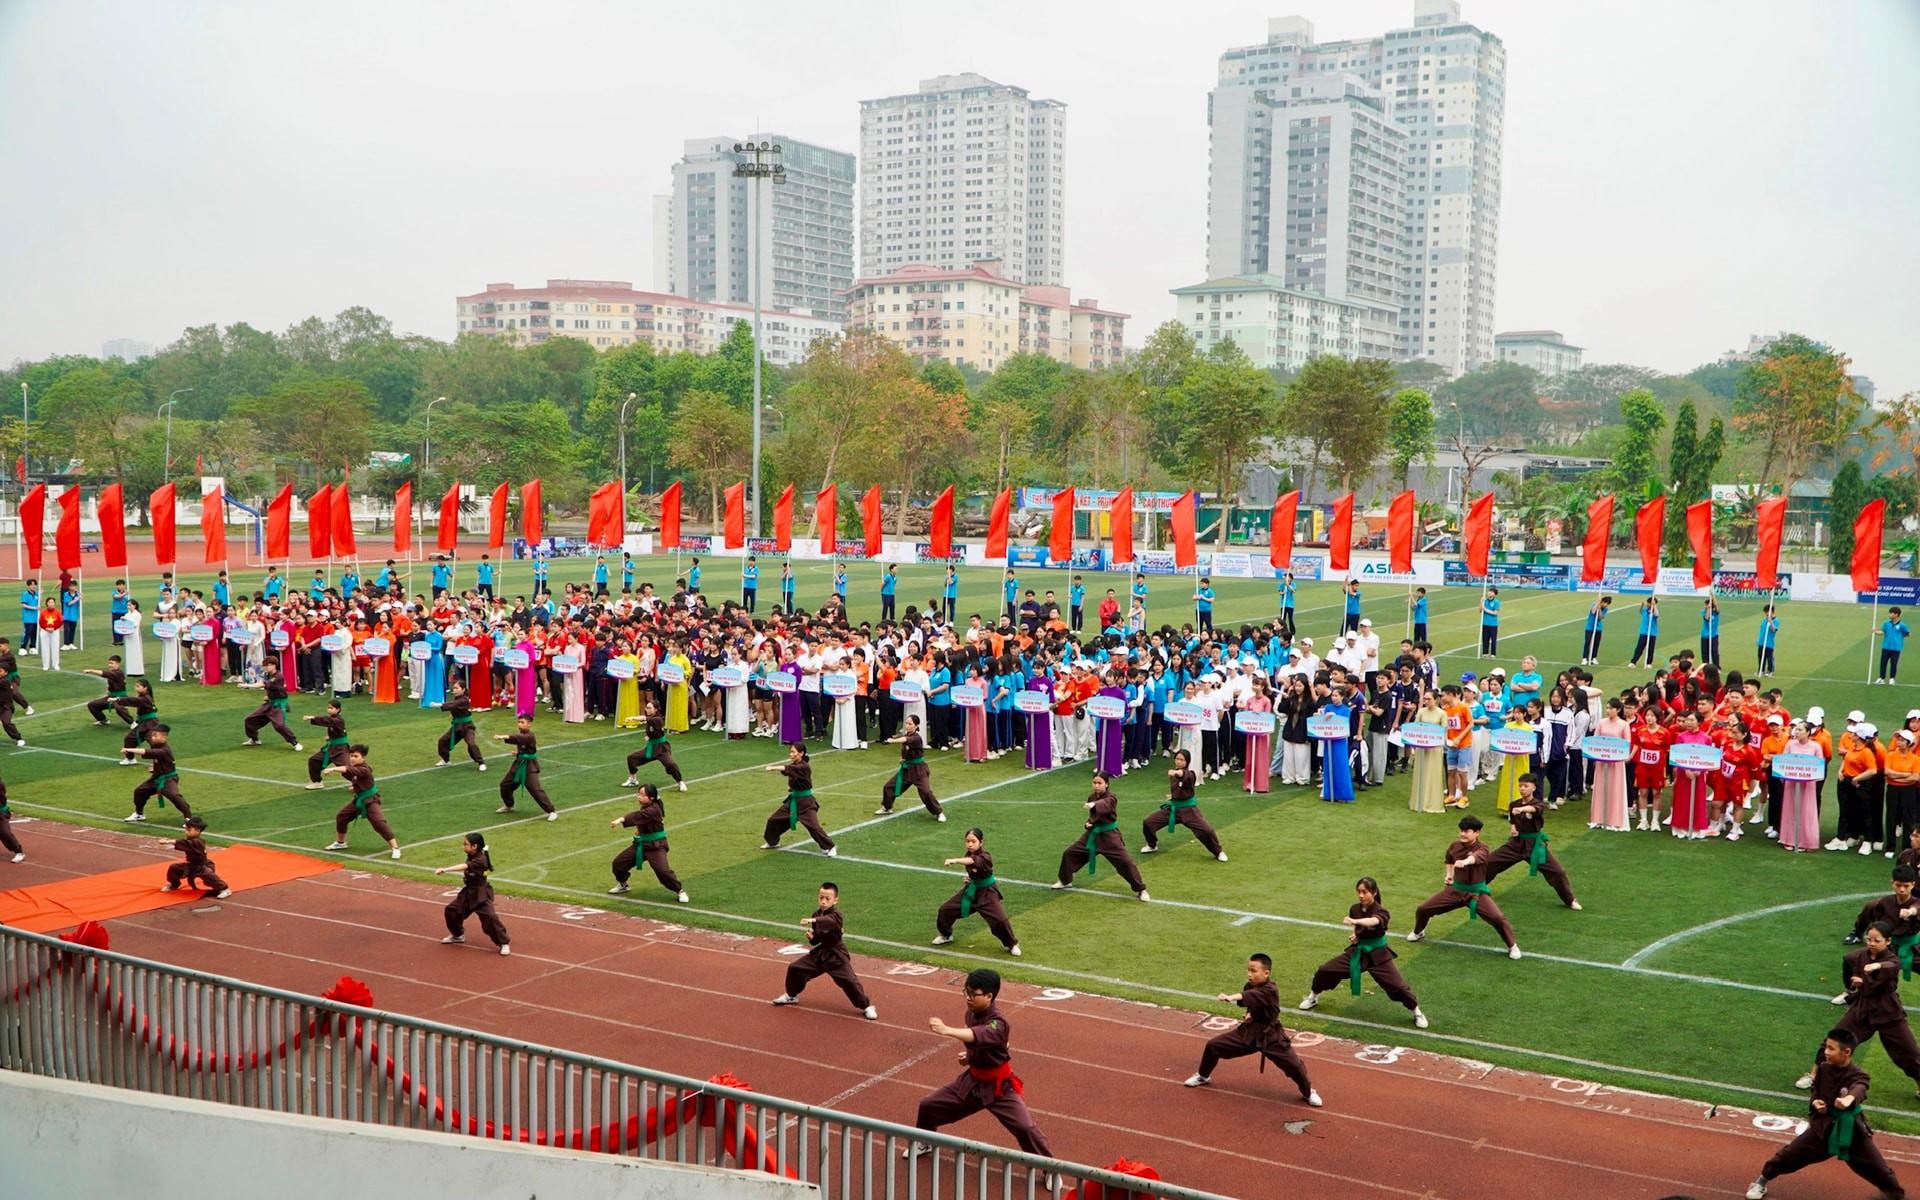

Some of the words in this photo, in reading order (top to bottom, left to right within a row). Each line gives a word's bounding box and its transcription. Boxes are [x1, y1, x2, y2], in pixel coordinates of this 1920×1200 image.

[1485, 700, 1501, 711] 483
[1203, 708, 1212, 718] 56
[1642, 751, 1657, 762] 166
